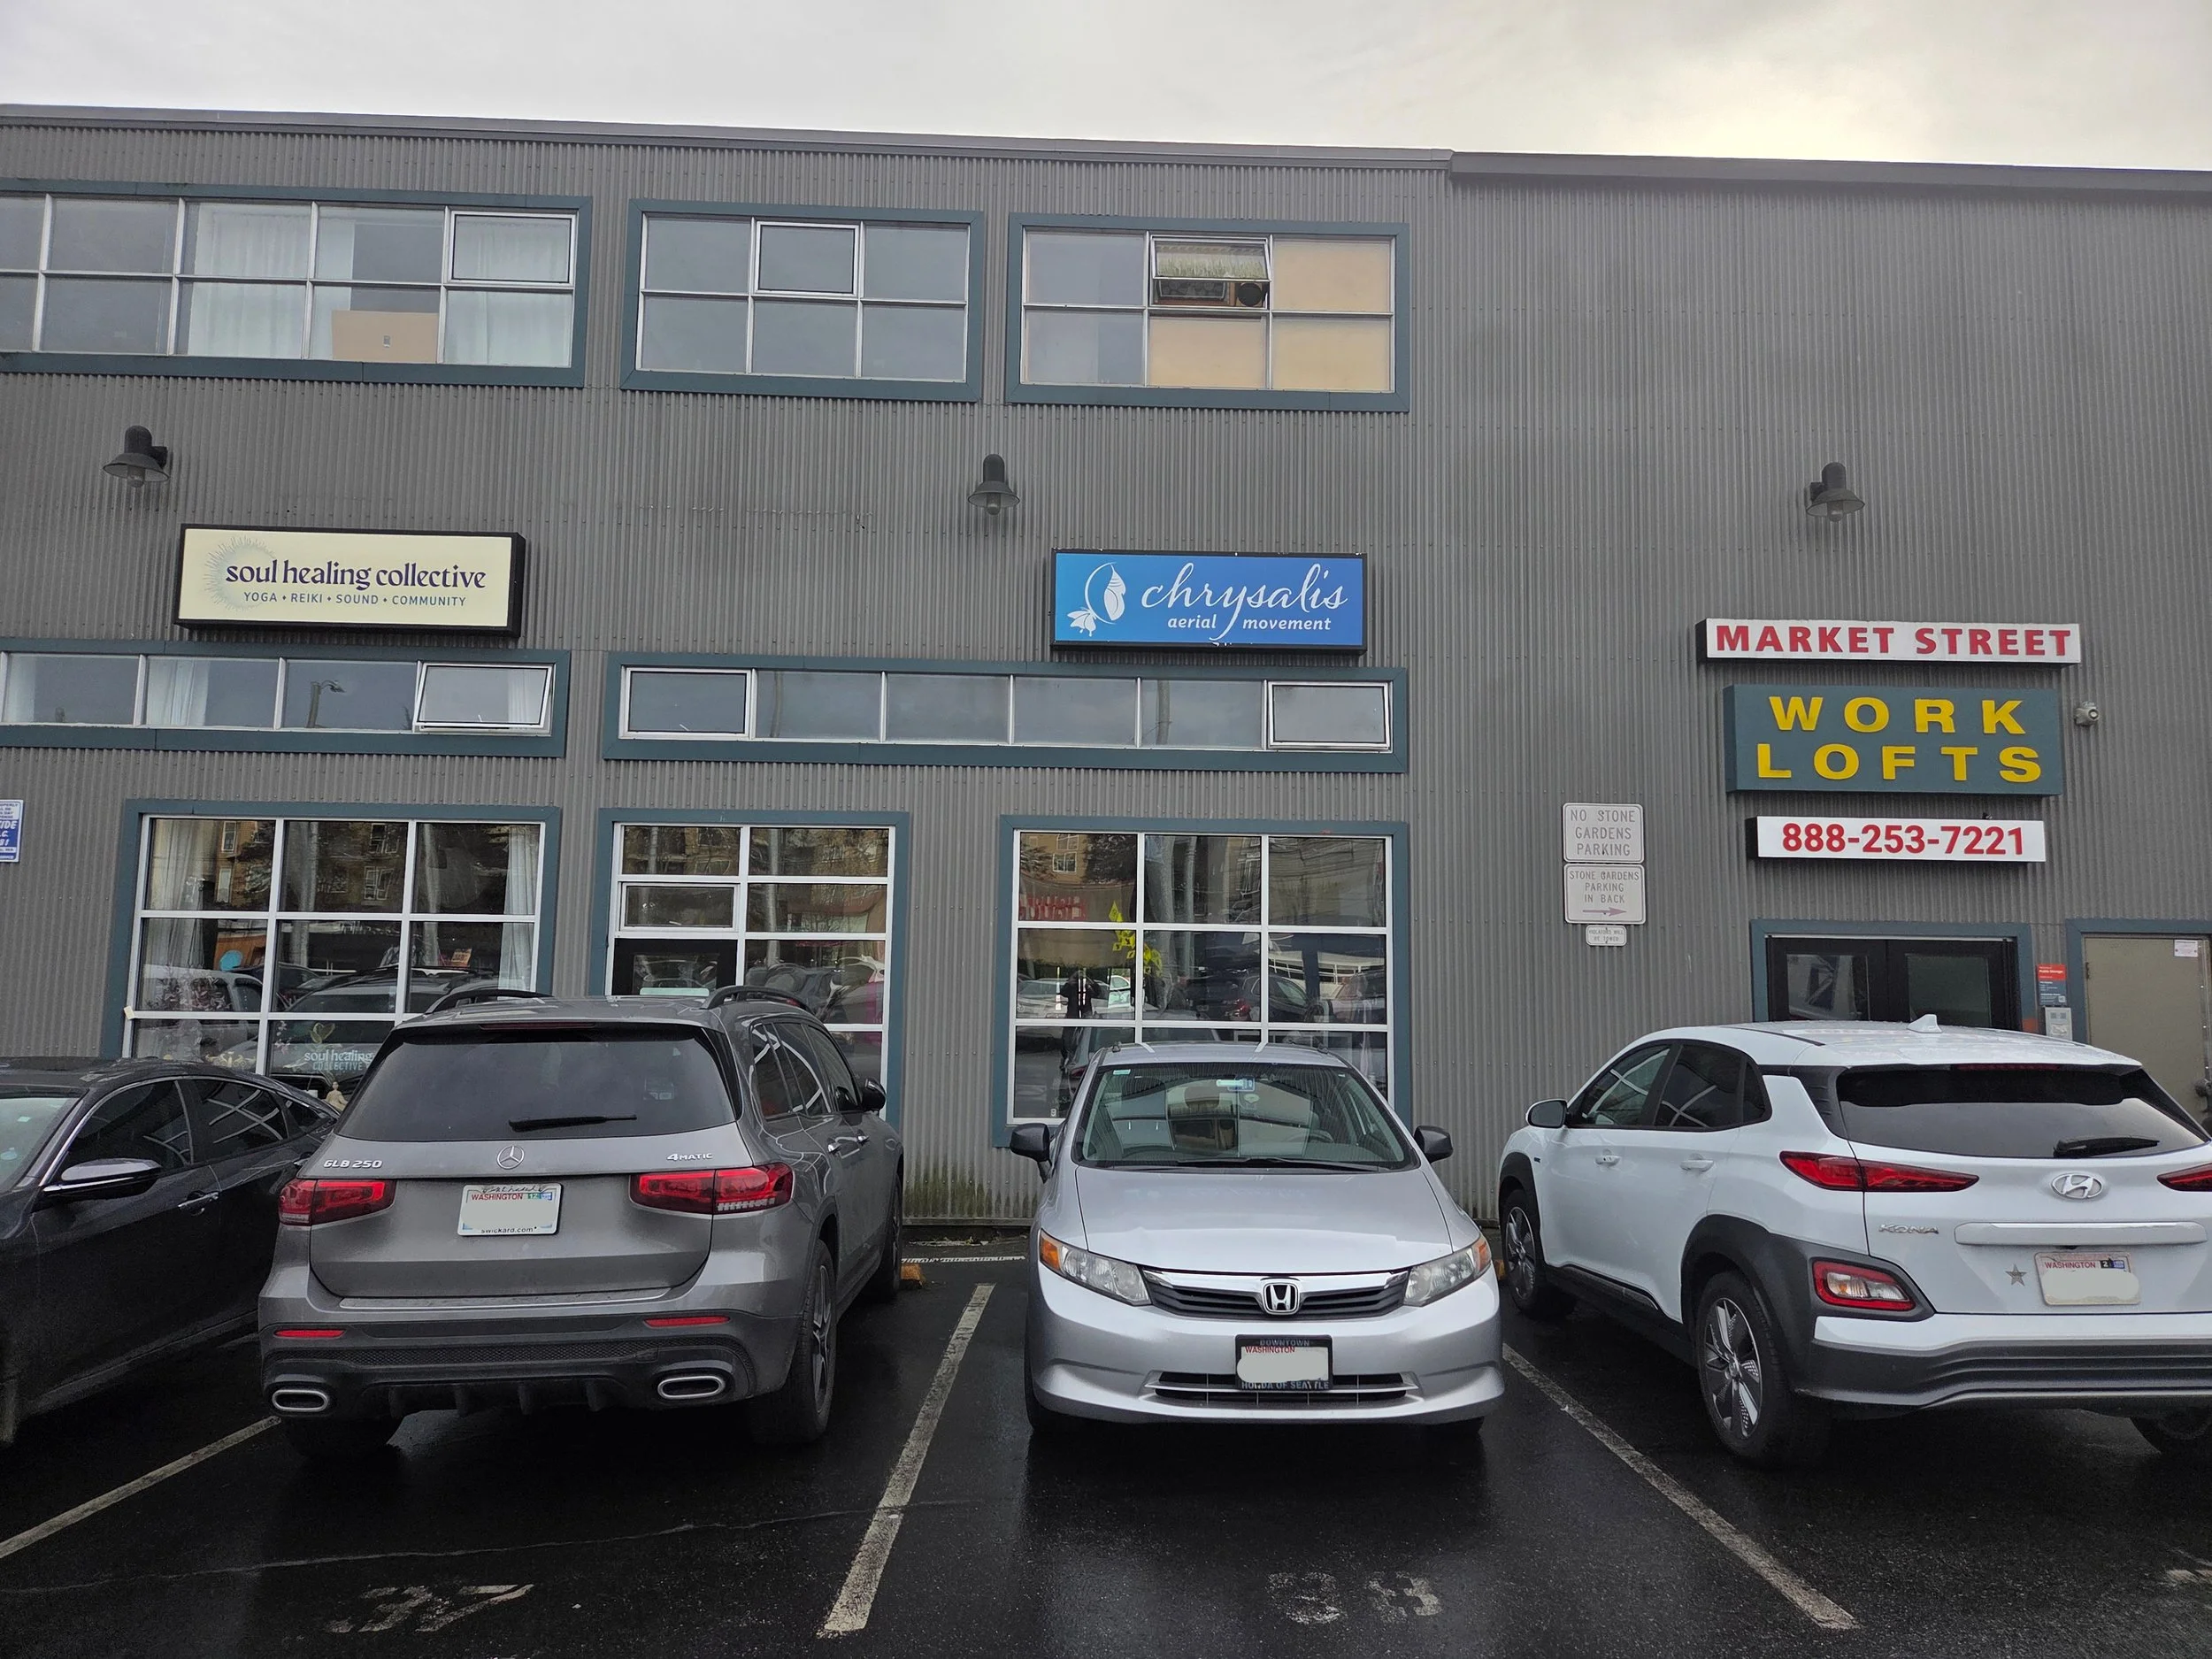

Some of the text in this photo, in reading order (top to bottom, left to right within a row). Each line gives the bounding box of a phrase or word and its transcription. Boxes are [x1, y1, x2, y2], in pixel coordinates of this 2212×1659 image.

[226, 559, 487, 591] soul healing collective
[244, 592, 466, 607] YOGA REIKI SOUND COMMUNITY
[1141, 562, 1348, 641] chrysalis
[1167, 614, 1332, 631] aerial movement
[1717, 626, 2071, 657] MARKET STREET
[1769, 695, 2026, 734] WORK
[1757, 743, 2042, 782] LOFTS
[1571, 810, 1636, 823] NO STONE
[1575, 826, 1632, 840] GARDENS
[1782, 823, 2024, 856] 888-253-7221
[1577, 843, 1631, 856] PARKING
[1569, 871, 1640, 880] STONE GARDENS
[1585, 883, 1624, 892] PARKING
[1585, 895, 1625, 903] IN BACK
[304, 1049, 373, 1063] soul healing
[323, 1159, 383, 1169] GLB 250
[1878, 1224, 1939, 1234] KONA
